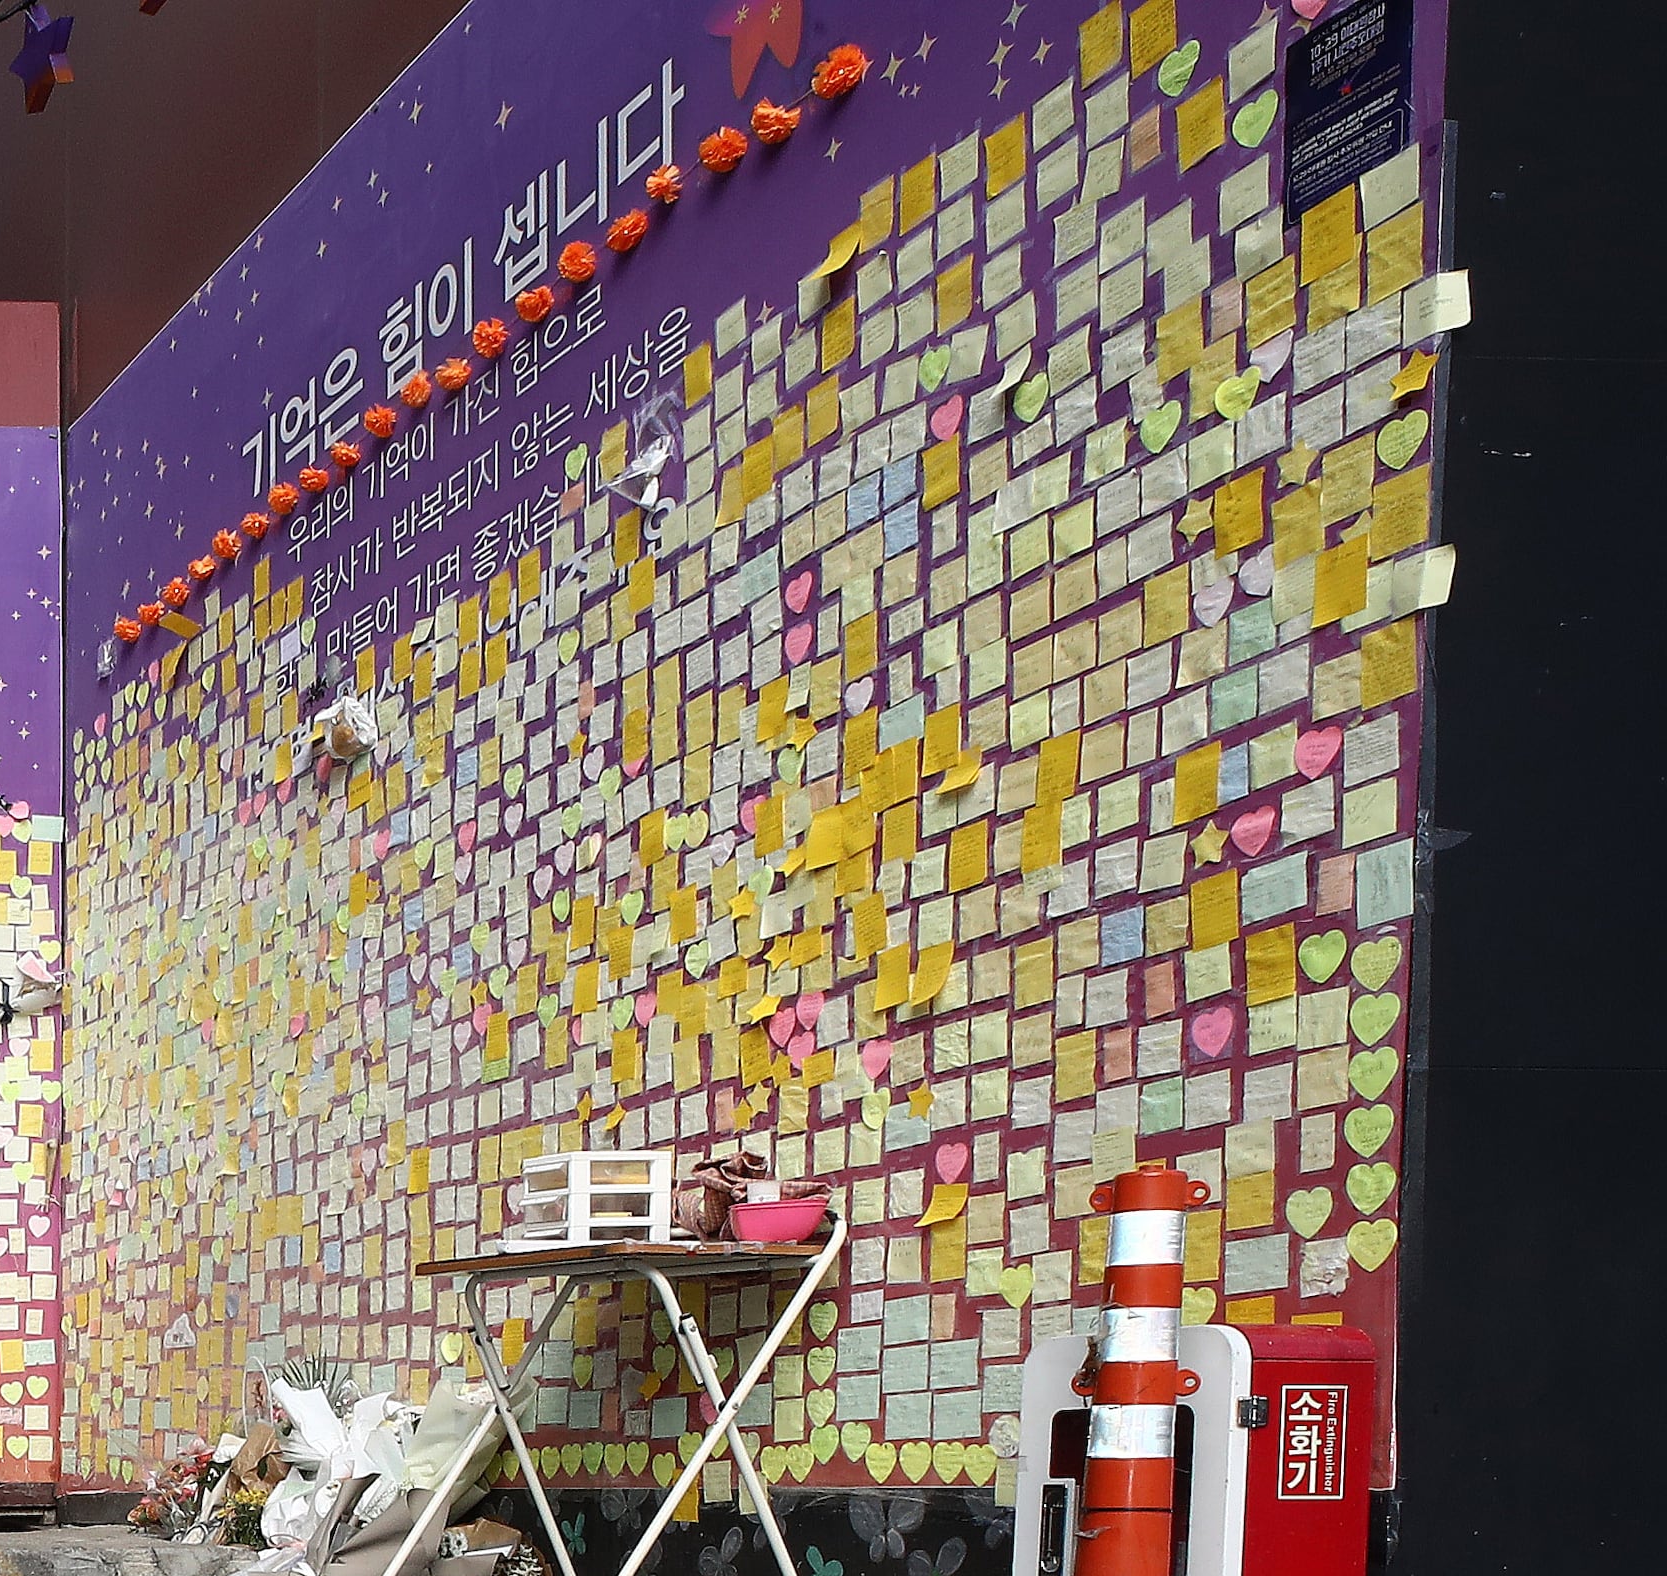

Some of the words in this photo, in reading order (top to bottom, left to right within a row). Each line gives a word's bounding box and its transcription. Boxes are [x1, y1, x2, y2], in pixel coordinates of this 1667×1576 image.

[241, 347, 364, 497] 기억은
[378, 236, 474, 400] 힘이
[493, 57, 685, 302] 셉니다
[286, 475, 355, 562] 우리의
[362, 411, 435, 499] 기억이
[444, 362, 500, 436] 가진
[509, 283, 607, 397] 힘으로
[310, 527, 384, 618] 참사가
[393, 440, 499, 560] 반복되지
[511, 402, 575, 480] 않는
[583, 306, 692, 418] 세상을
[406, 545, 463, 613] 가면
[1286, 1391, 1323, 1494] 소화기
